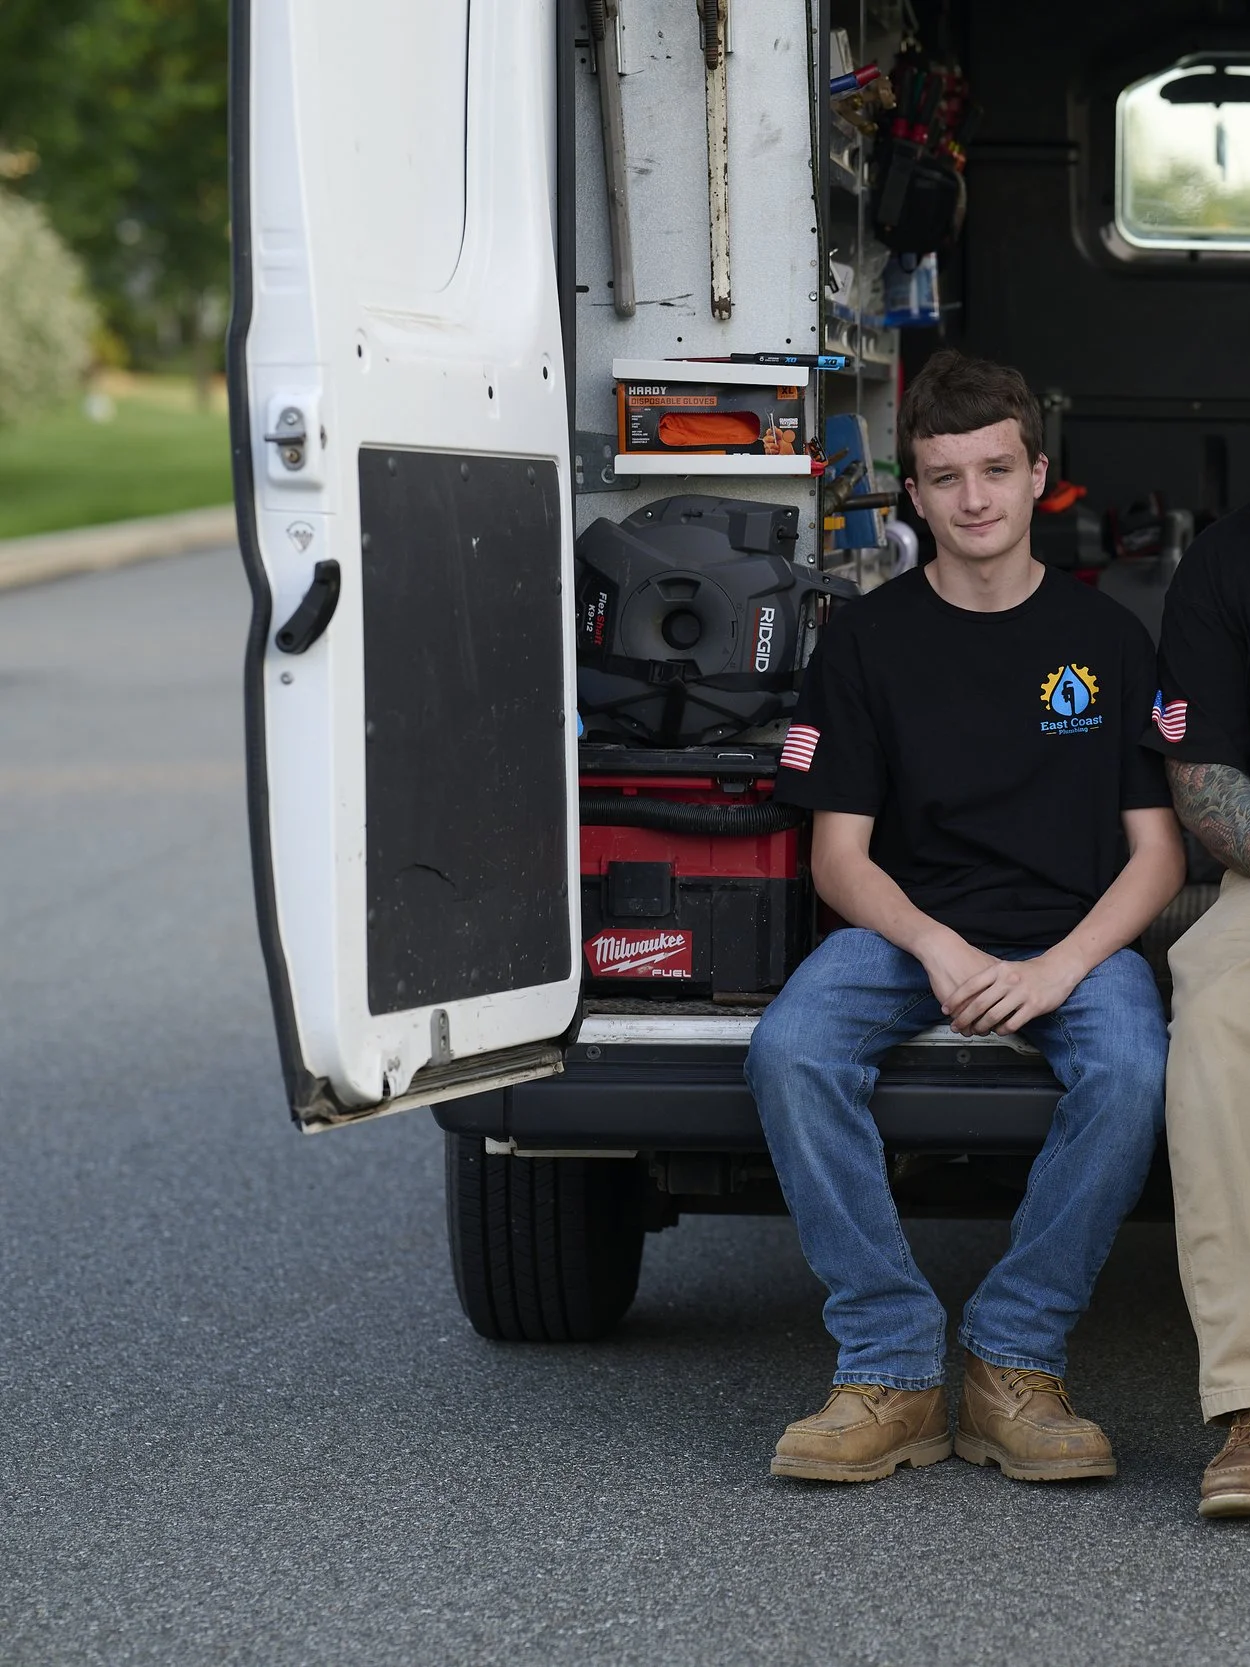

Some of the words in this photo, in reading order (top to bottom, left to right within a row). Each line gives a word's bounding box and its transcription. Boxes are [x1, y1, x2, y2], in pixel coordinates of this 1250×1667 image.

[628, 386, 668, 395] HARDY
[781, 386, 793, 394] XL
[631, 397, 681, 405] DISPOSABLE
[682, 397, 715, 405] GLOVES
[585, 603, 596, 633] K9-12
[593, 591, 608, 646] FlexShaft
[755, 607, 775, 673] RIDGID
[1040, 719, 1068, 731] East
[1070, 714, 1103, 727] Coast
[1058, 726, 1089, 735] Plumbing
[591, 932, 686, 965] Milwaukee
[651, 969, 692, 978] FUEL
